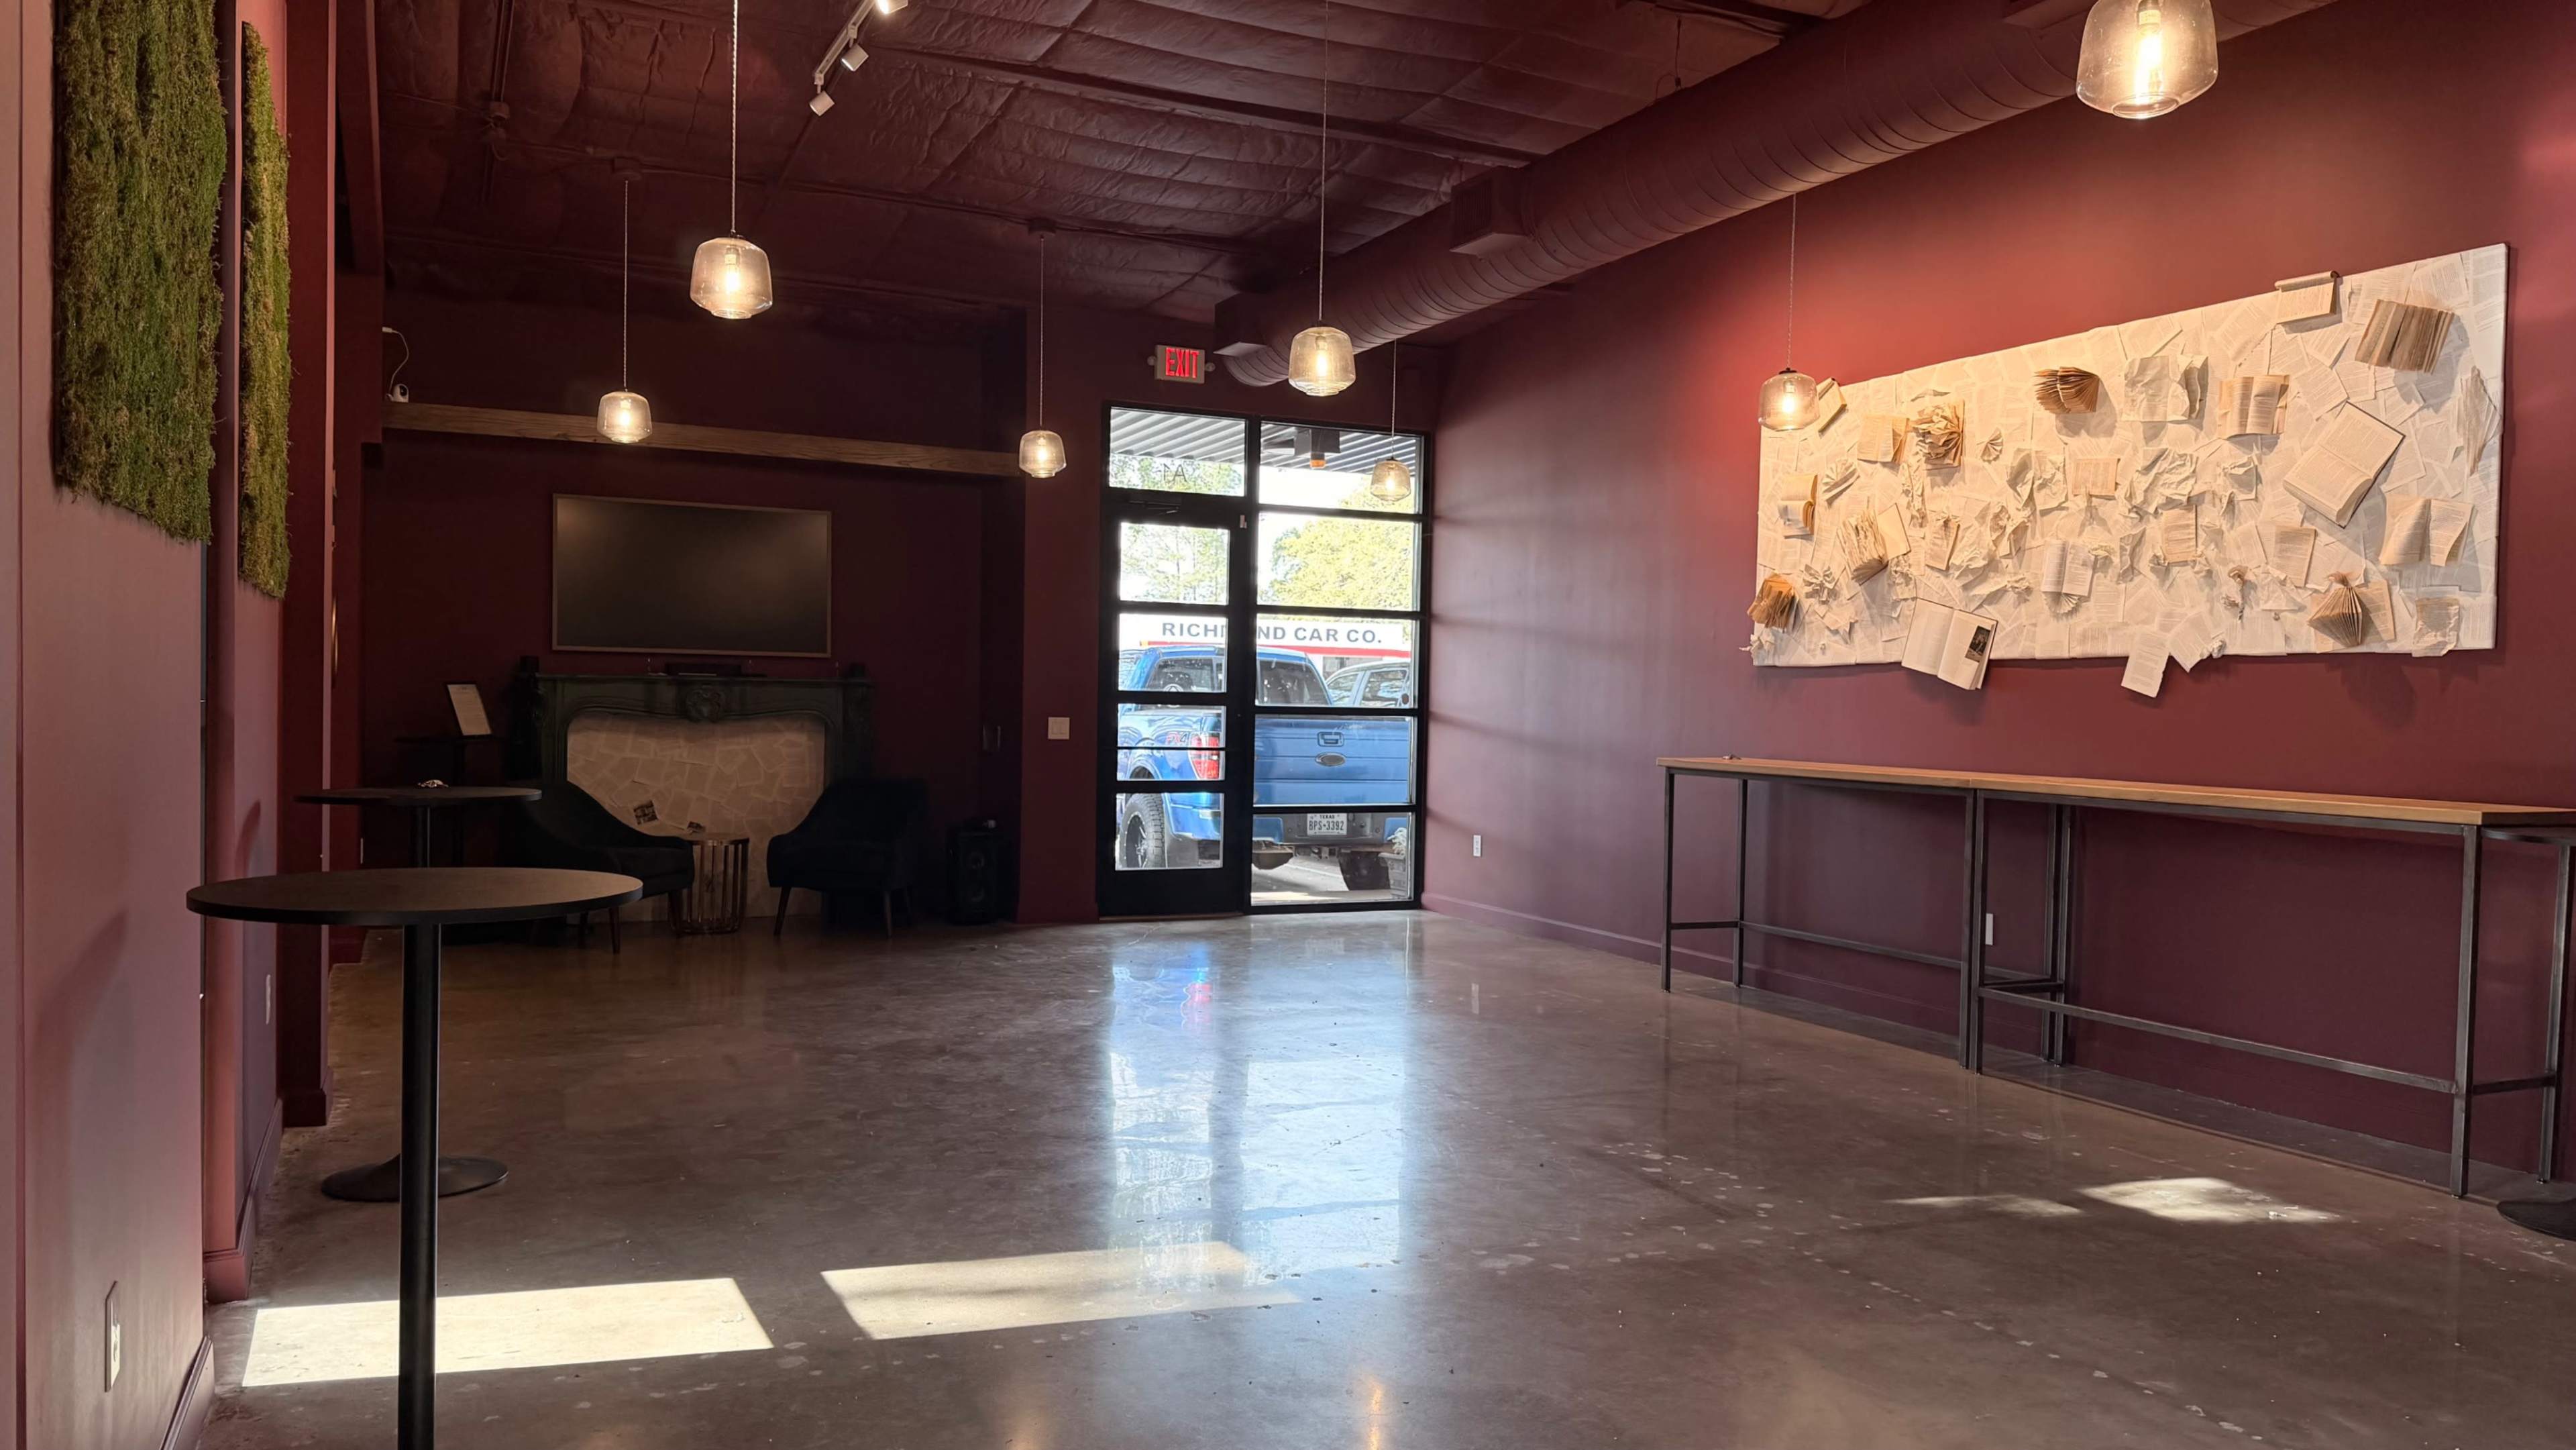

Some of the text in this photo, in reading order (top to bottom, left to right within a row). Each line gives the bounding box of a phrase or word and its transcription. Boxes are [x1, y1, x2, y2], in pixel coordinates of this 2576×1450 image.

[1166, 348, 1199, 378] EXIT
[1163, 623, 1381, 643] RICHND CAR CO.
